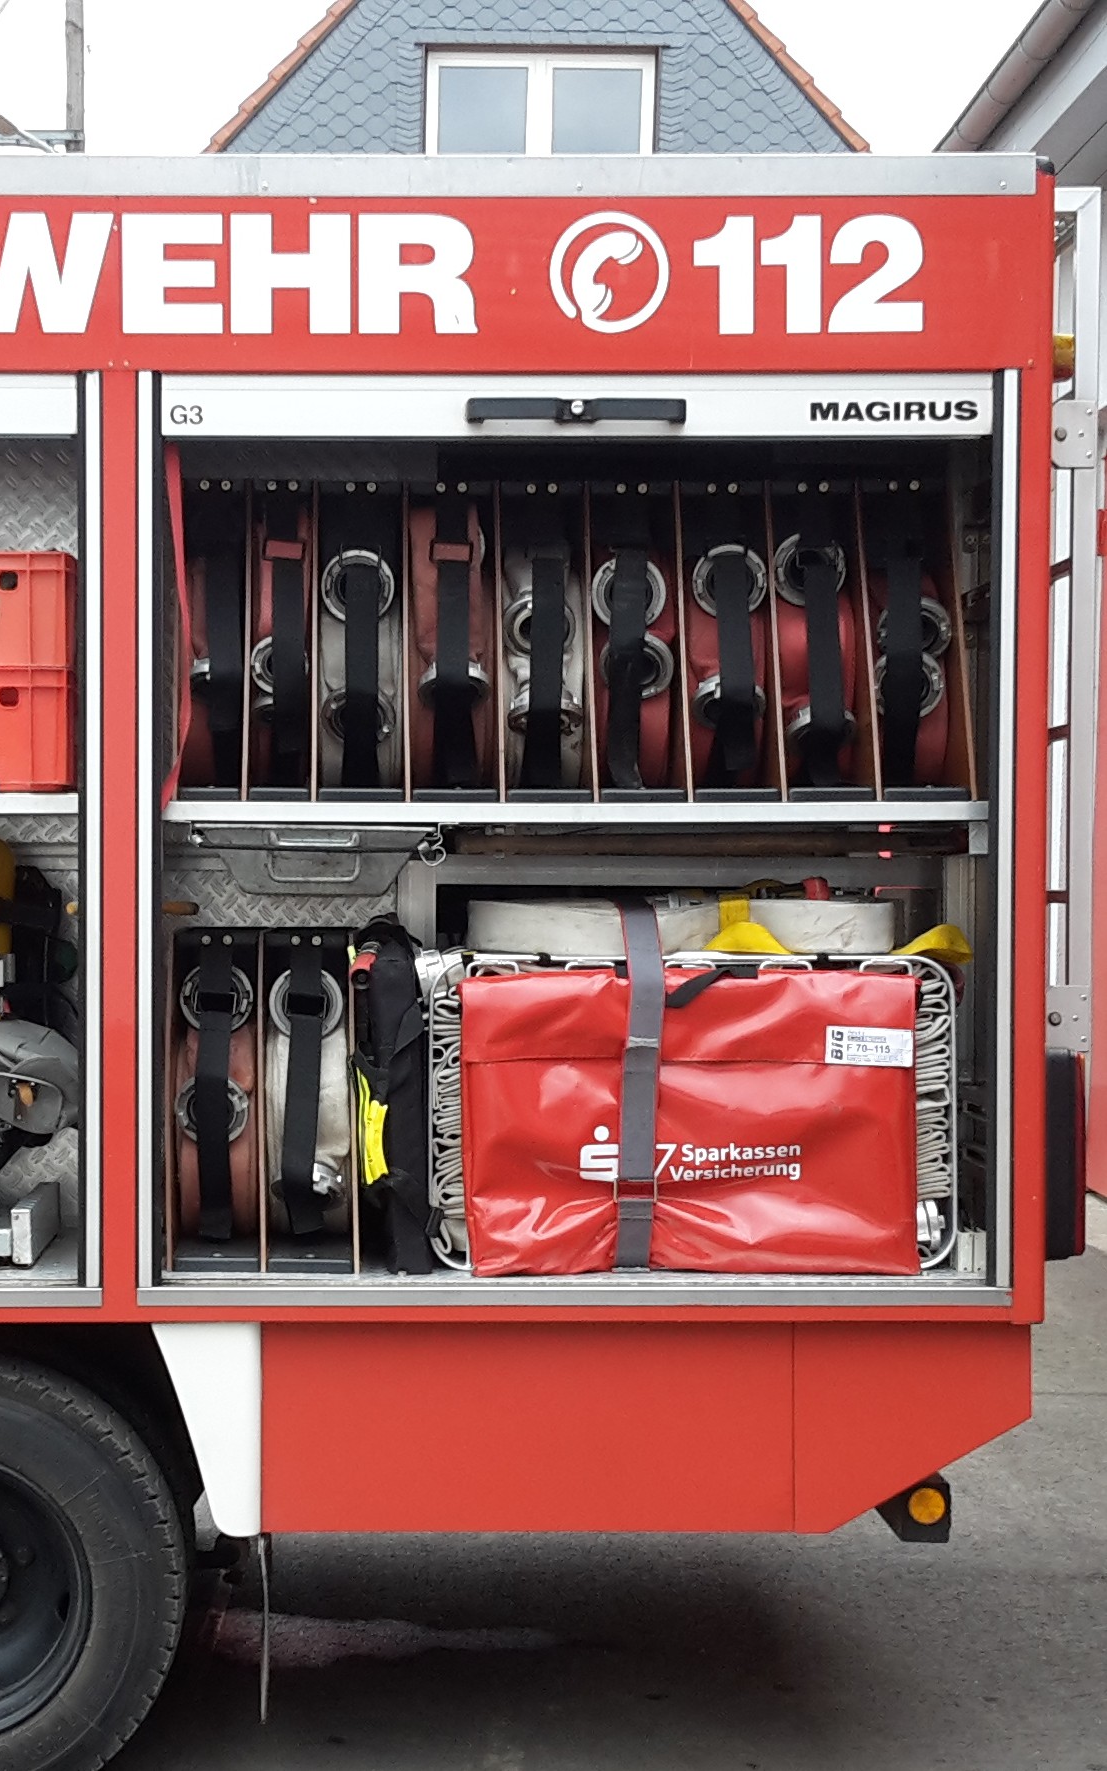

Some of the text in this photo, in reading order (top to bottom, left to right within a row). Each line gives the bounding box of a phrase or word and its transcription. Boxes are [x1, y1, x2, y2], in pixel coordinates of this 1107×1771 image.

[692, 214, 925, 335] 112
[169, 404, 204, 425] G3
[809, 400, 979, 422] MAGIRUS
[681, 1142, 801, 1166] Sparkassen
[668, 1161, 801, 1181] Versicherung
